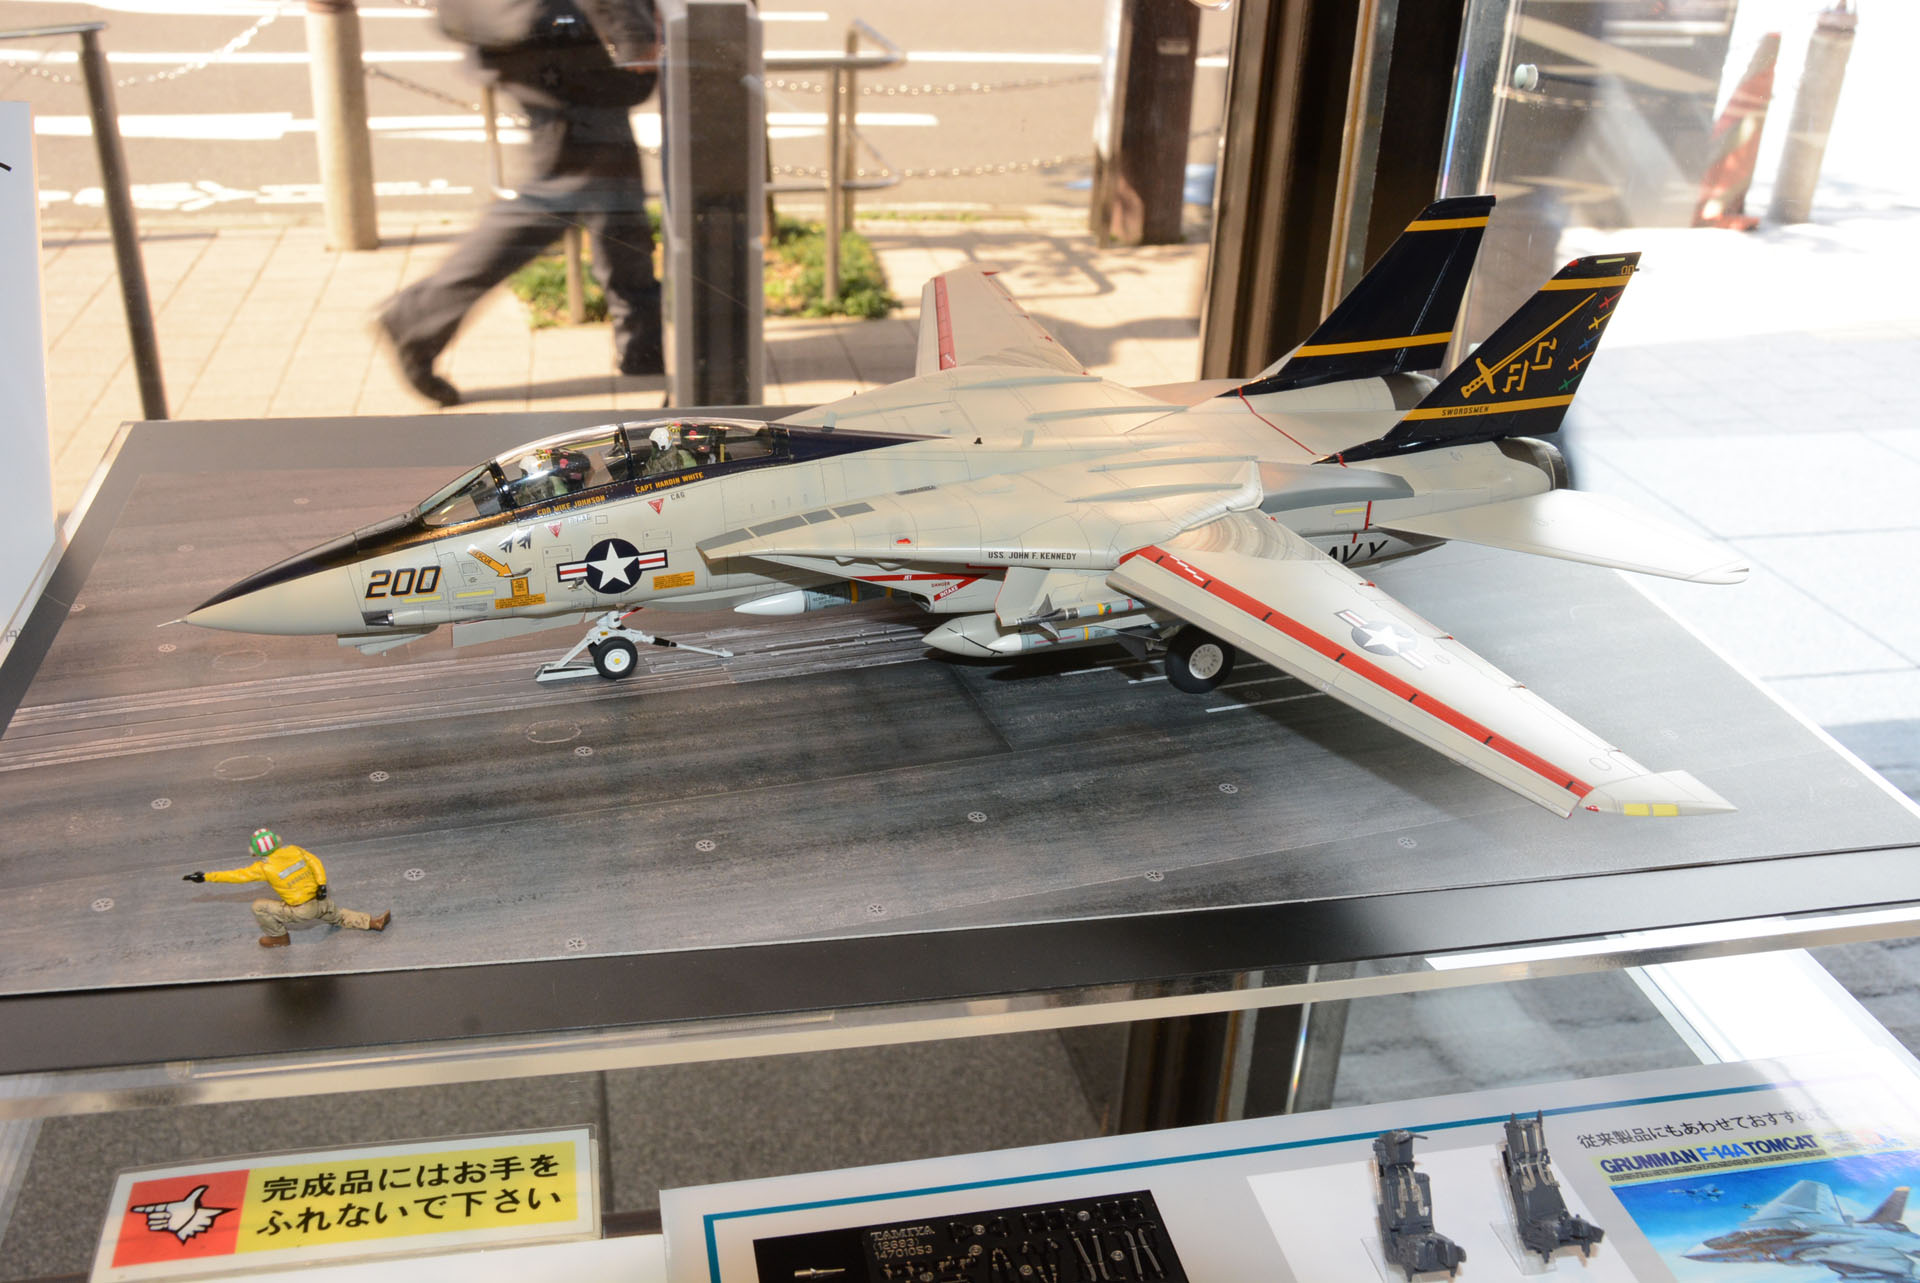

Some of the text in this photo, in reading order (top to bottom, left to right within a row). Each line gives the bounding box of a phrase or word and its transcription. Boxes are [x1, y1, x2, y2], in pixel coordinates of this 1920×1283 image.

[1442, 406, 1490, 417] SWORDSMEN
[635, 484, 653, 494] CAPT
[682, 471, 704, 482] WHITE
[553, 502, 572, 512] MIKE
[573, 495, 606, 509] JOHNSON
[472, 549, 492, 565] ESCUE
[1008, 552, 1030, 560] JOHN
[1040, 552, 1078, 561] KENNEDY
[1328, 540, 1389, 563] AVY
[365, 565, 442, 599] 200
[1600, 1148, 1701, 1174] GRUMMAN
[1696, 1142, 1750, 1162] F-14A
[1742, 1134, 1819, 1156] TOMCAT
[261, 1153, 559, 1204] 完成品にはお手を
[256, 1186, 562, 1236] ふれないで下さい
[870, 1226, 935, 1241] TAMIYA
